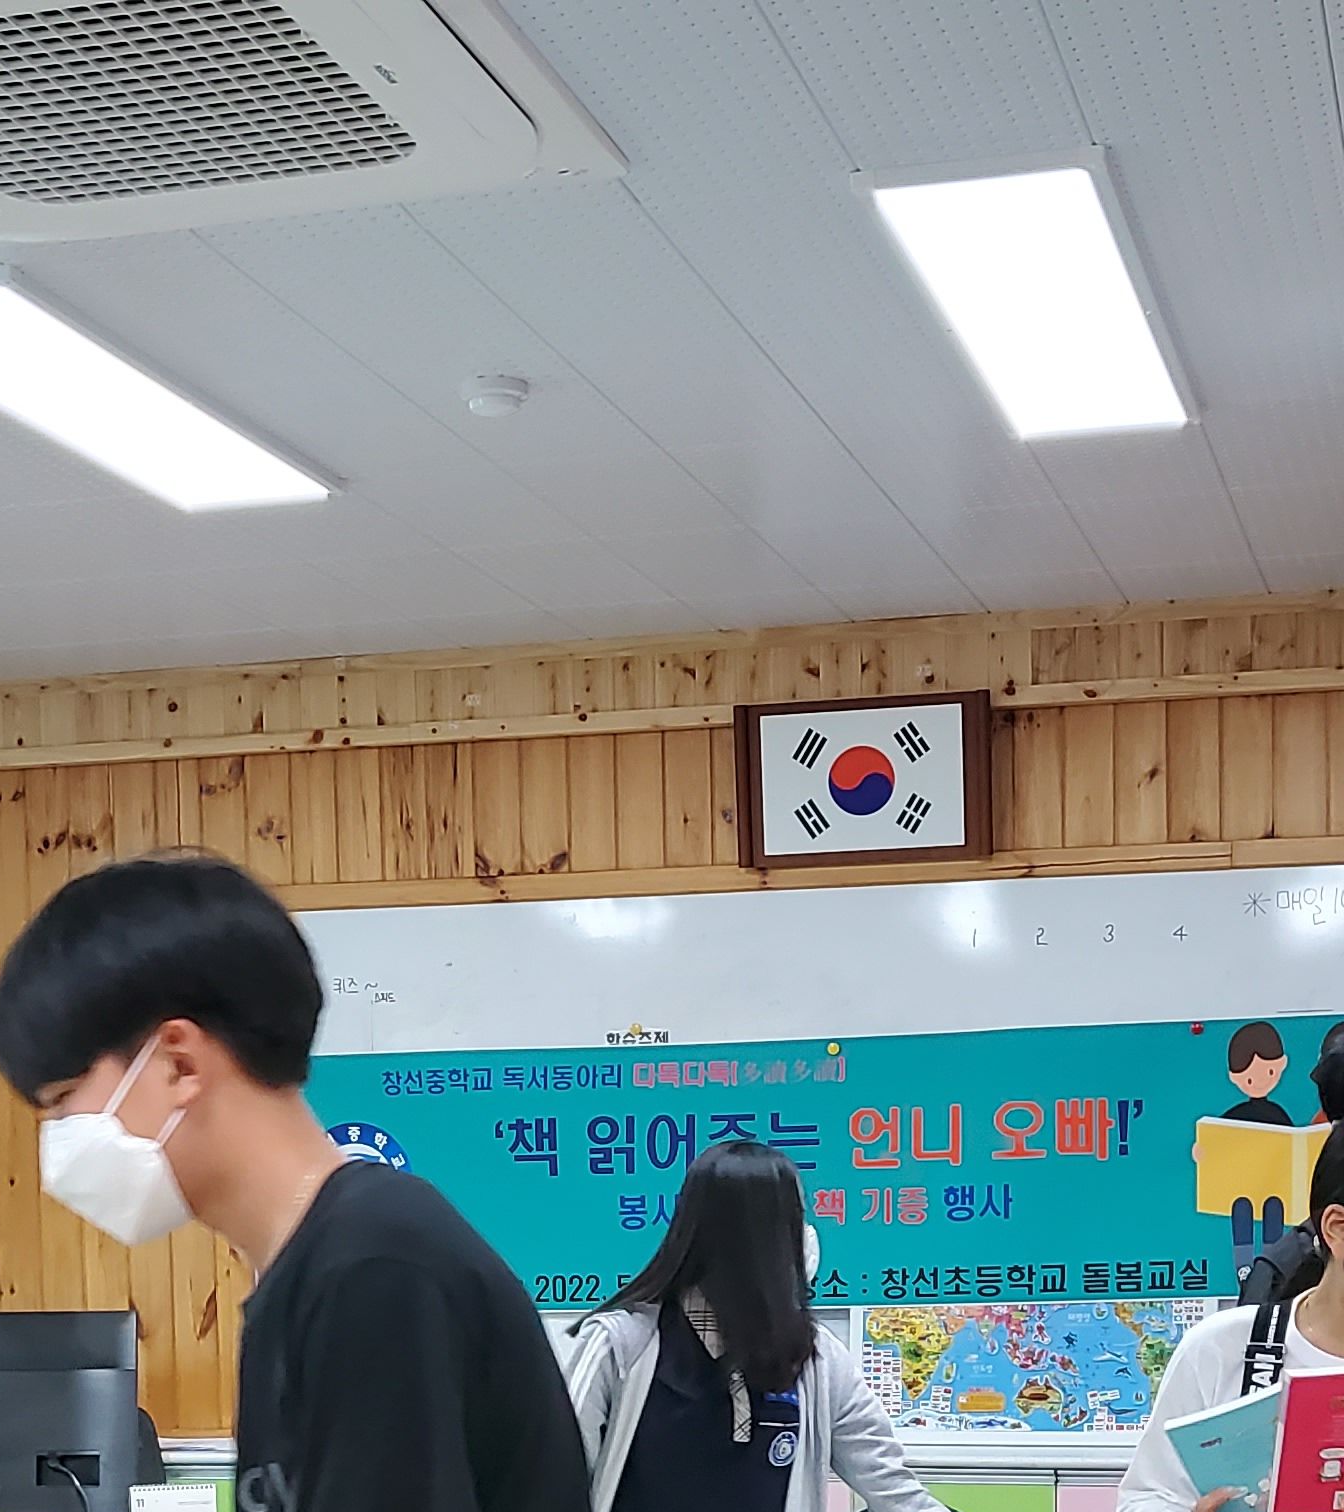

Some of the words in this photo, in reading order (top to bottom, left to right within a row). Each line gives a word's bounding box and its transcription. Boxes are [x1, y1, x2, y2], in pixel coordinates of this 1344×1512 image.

[1035, 927, 1049, 946] 2
[1102, 924, 1115, 943] 3
[1172, 925, 1189, 942] 4
[333, 977, 359, 994] 퀴즈
[381, 1067, 493, 1096] 창선중학교
[503, 1063, 623, 1092] 독서동아리
[848, 1103, 962, 1169] 언니
[813, 1188, 846, 1226] 책
[859, 1186, 929, 1225] 기증
[942, 1183, 1013, 1223] 행사
[534, 1273, 607, 1303] 2022.
[880, 1263, 1068, 1299] 창선초등학교
[1081, 1258, 1209, 1294] 돌봄교실
